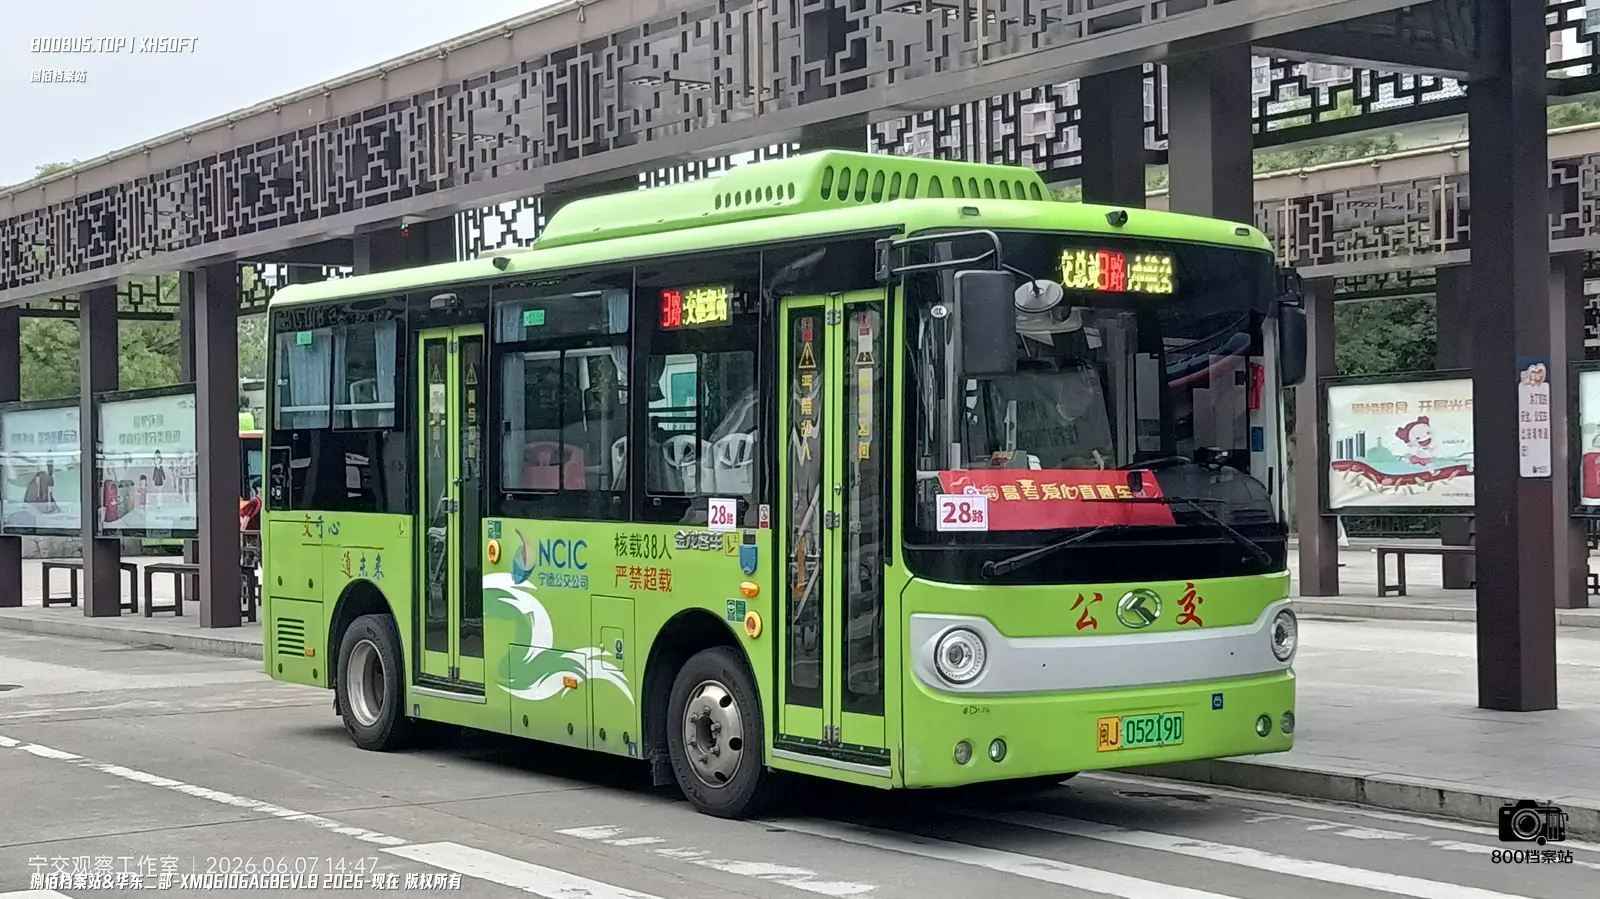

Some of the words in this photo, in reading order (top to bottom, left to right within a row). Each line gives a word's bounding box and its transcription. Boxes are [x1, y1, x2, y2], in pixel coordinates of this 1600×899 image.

[711, 505, 734, 525] 28路
[943, 502, 984, 524] 28路
[539, 538, 588, 570] NCIC
[614, 531, 672, 561] 核载38人
[538, 571, 589, 590] 宁德公交公司
[615, 565, 672, 592] 严禁超载
[1070, 592, 1103, 630] 公
[1175, 582, 1204, 628] 交
[1126, 716, 1182, 744] 05219D
